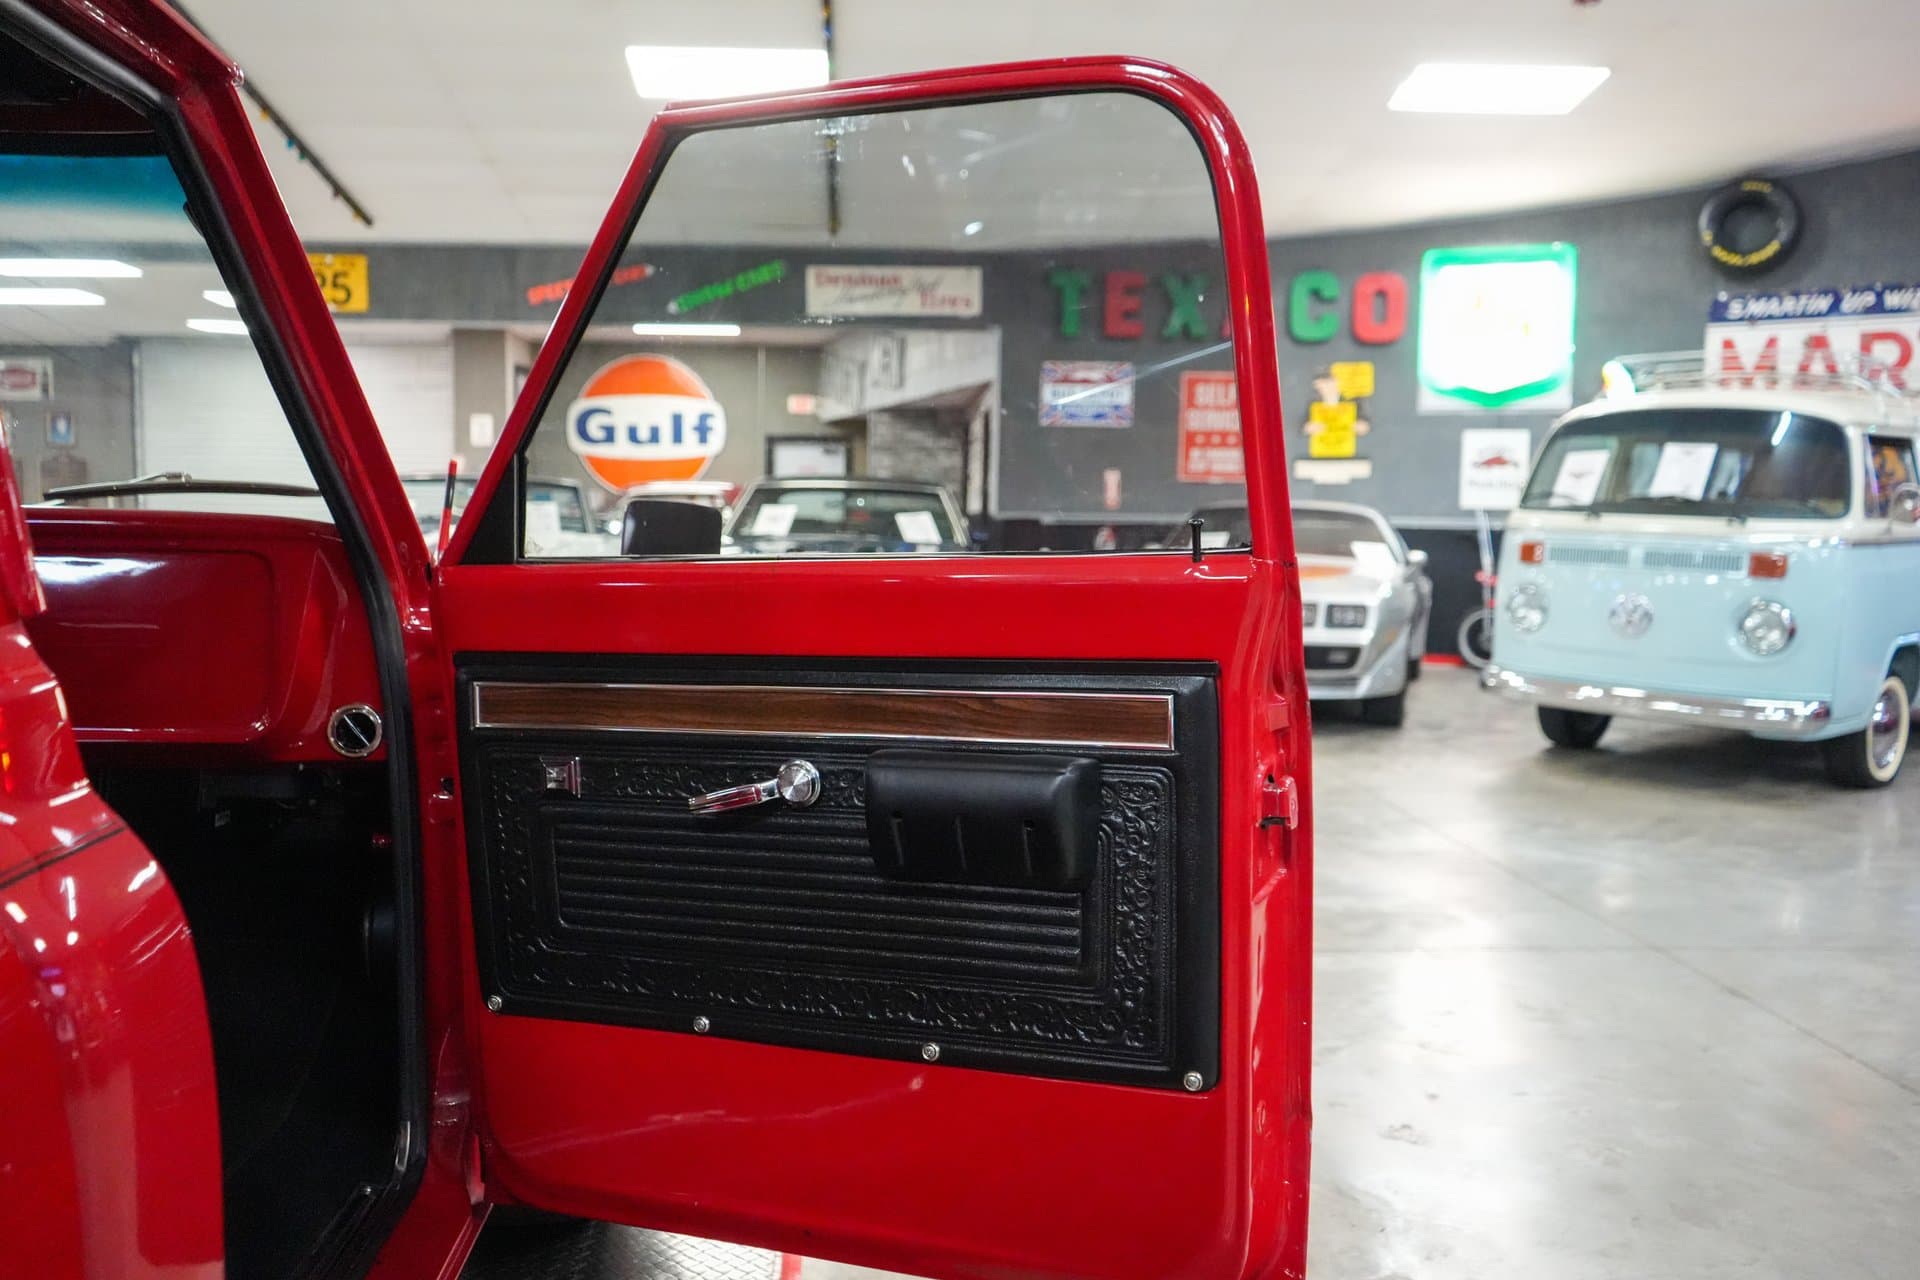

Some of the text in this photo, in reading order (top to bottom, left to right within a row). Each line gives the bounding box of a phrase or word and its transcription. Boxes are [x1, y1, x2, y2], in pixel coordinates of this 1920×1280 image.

[1049, 268, 1410, 344] TEXCO
[1839, 290, 1877, 313] UP
[1718, 331, 1920, 391] MAR
[576, 408, 715, 444] Gulf
